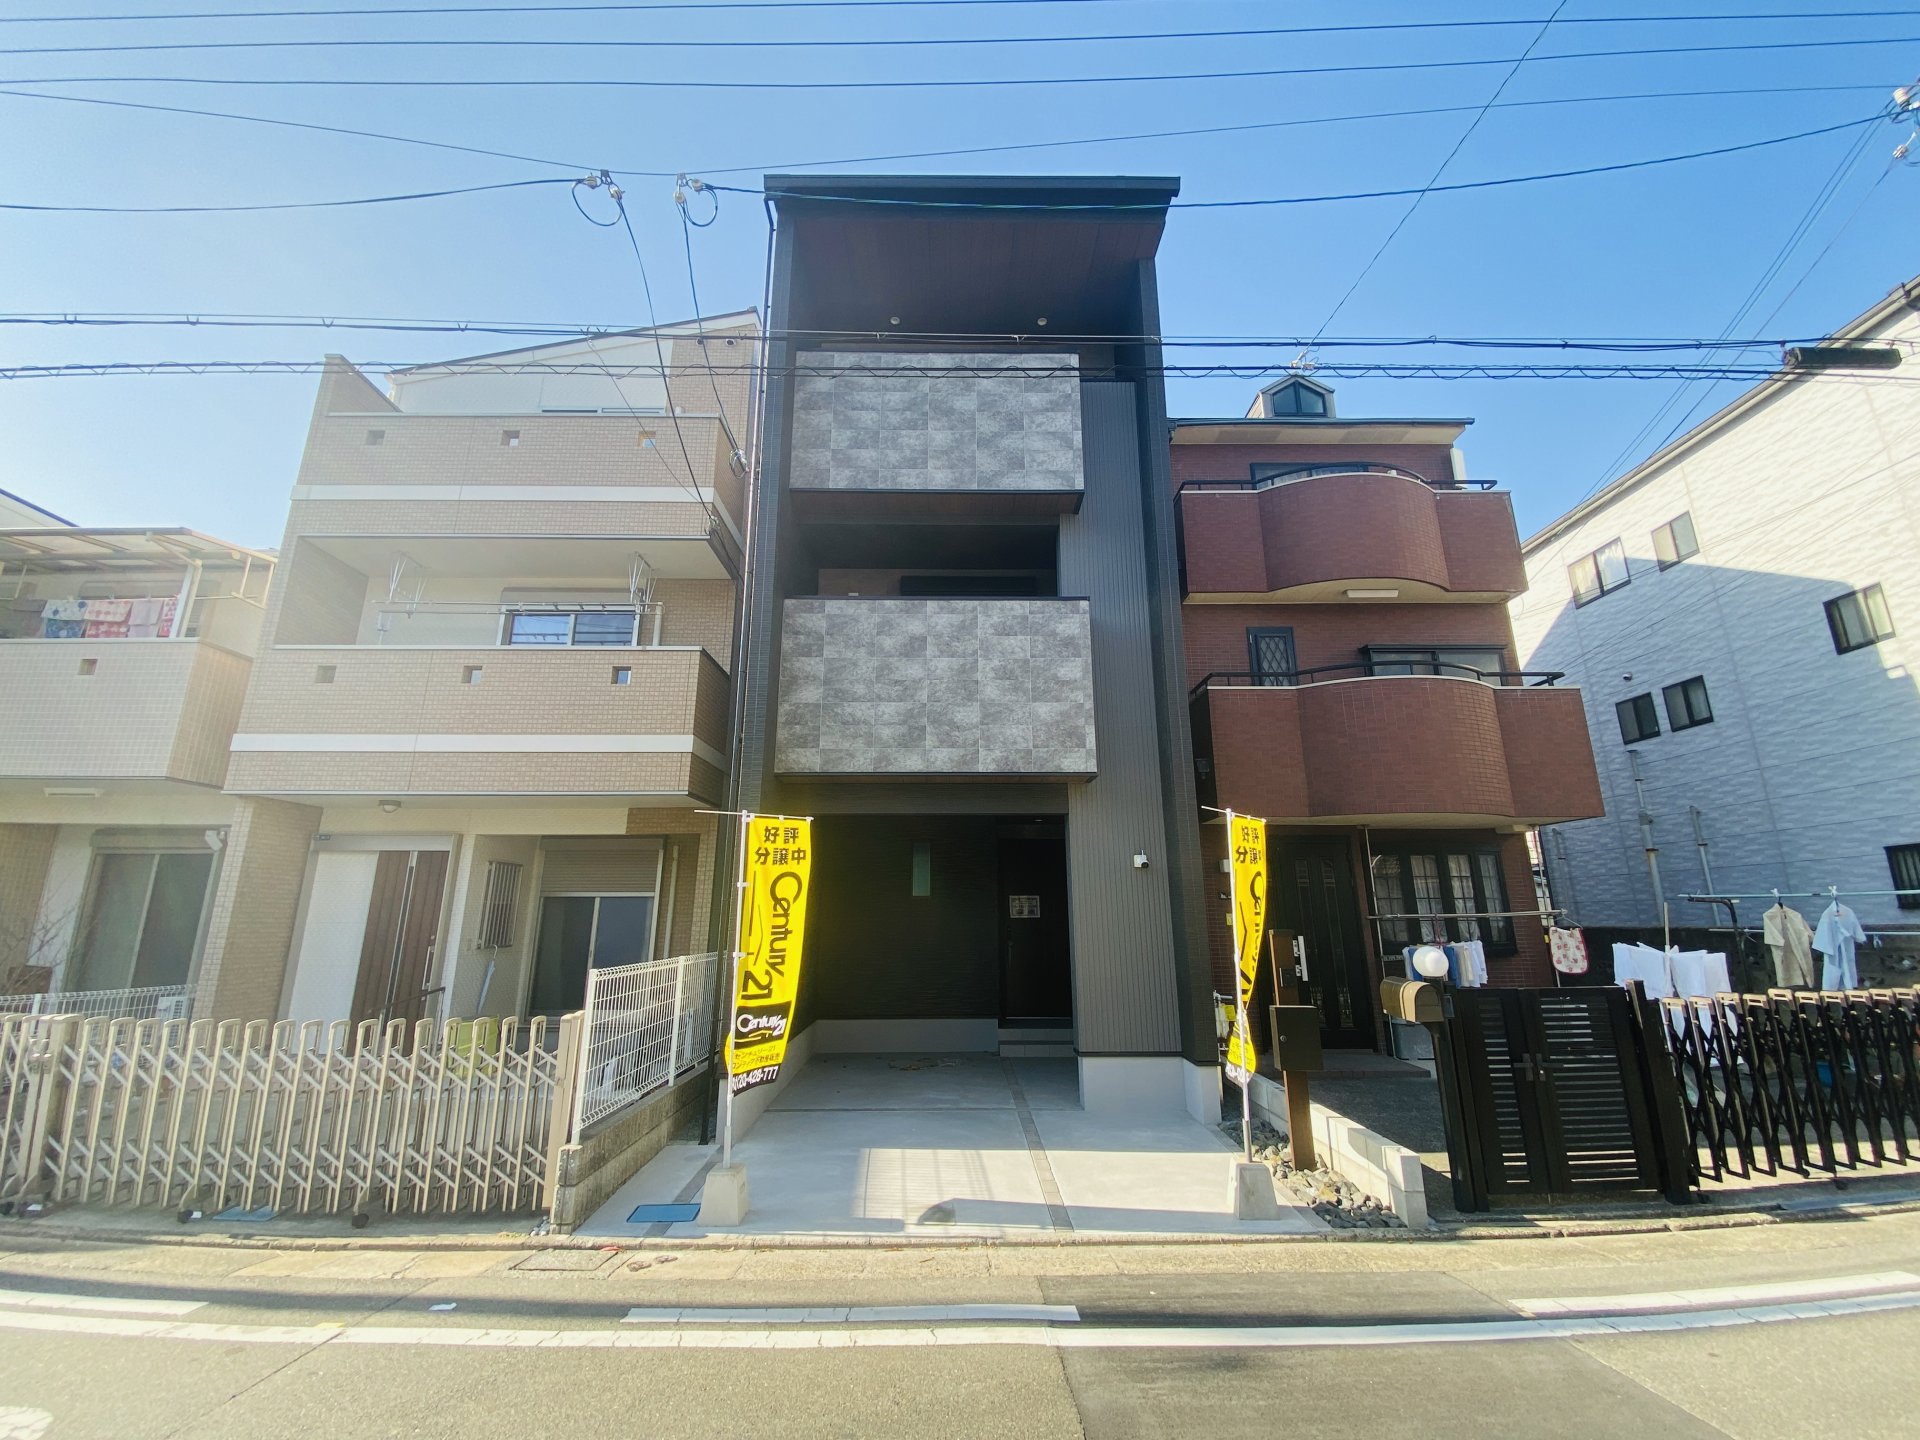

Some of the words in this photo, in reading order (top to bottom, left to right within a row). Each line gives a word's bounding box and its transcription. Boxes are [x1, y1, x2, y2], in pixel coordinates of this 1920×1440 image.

[764, 826, 799, 844] 好評
[755, 847, 806, 865] 分譲中
[765, 871, 803, 977] Century
[741, 969, 773, 1000] 21
